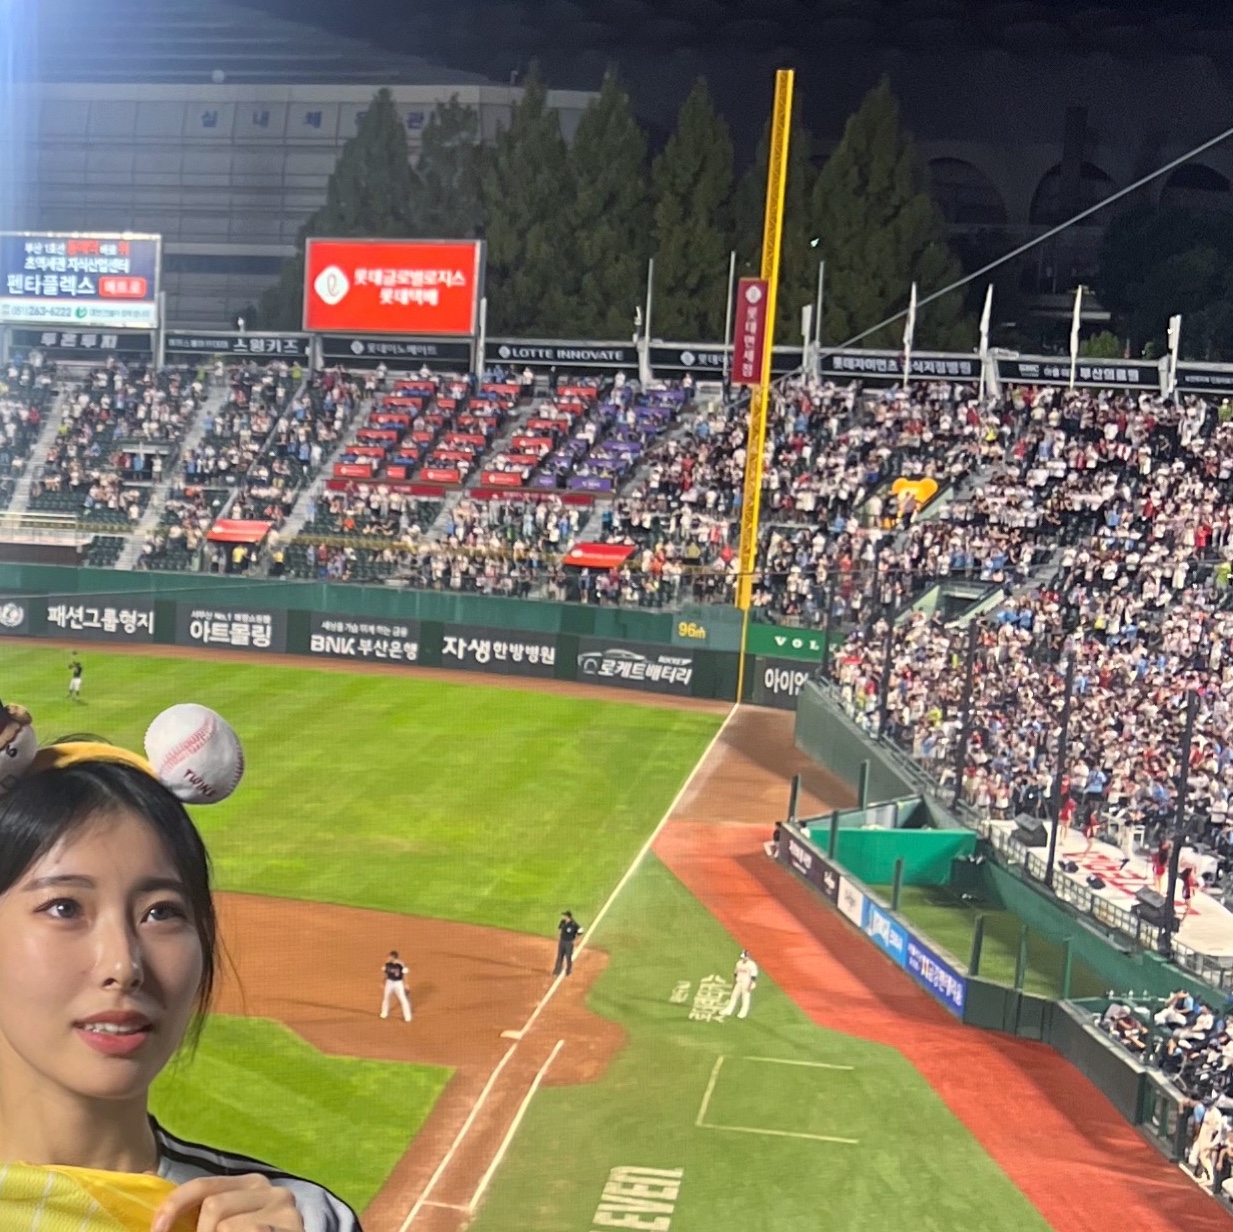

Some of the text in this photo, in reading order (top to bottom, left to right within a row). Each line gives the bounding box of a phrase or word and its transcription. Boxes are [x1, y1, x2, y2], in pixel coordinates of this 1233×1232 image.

[7, 274, 96, 296] 펜타플렉스
[354, 268, 466, 288] 롯데글로벌로지스
[379, 288, 439, 306] 롯데택배
[512, 348, 623, 361] LOTTE INNOVATE
[902, 359, 972, 375] 식지정병원
[47, 604, 155, 634] 패션그룹형지
[678, 621, 706, 639] 96m
[190, 620, 272, 648] 아트몰링
[310, 634, 419, 661] BNK 부산은행
[442, 635, 555, 664] 자생한방병원
[597, 659, 693, 686] 로케트배터리
